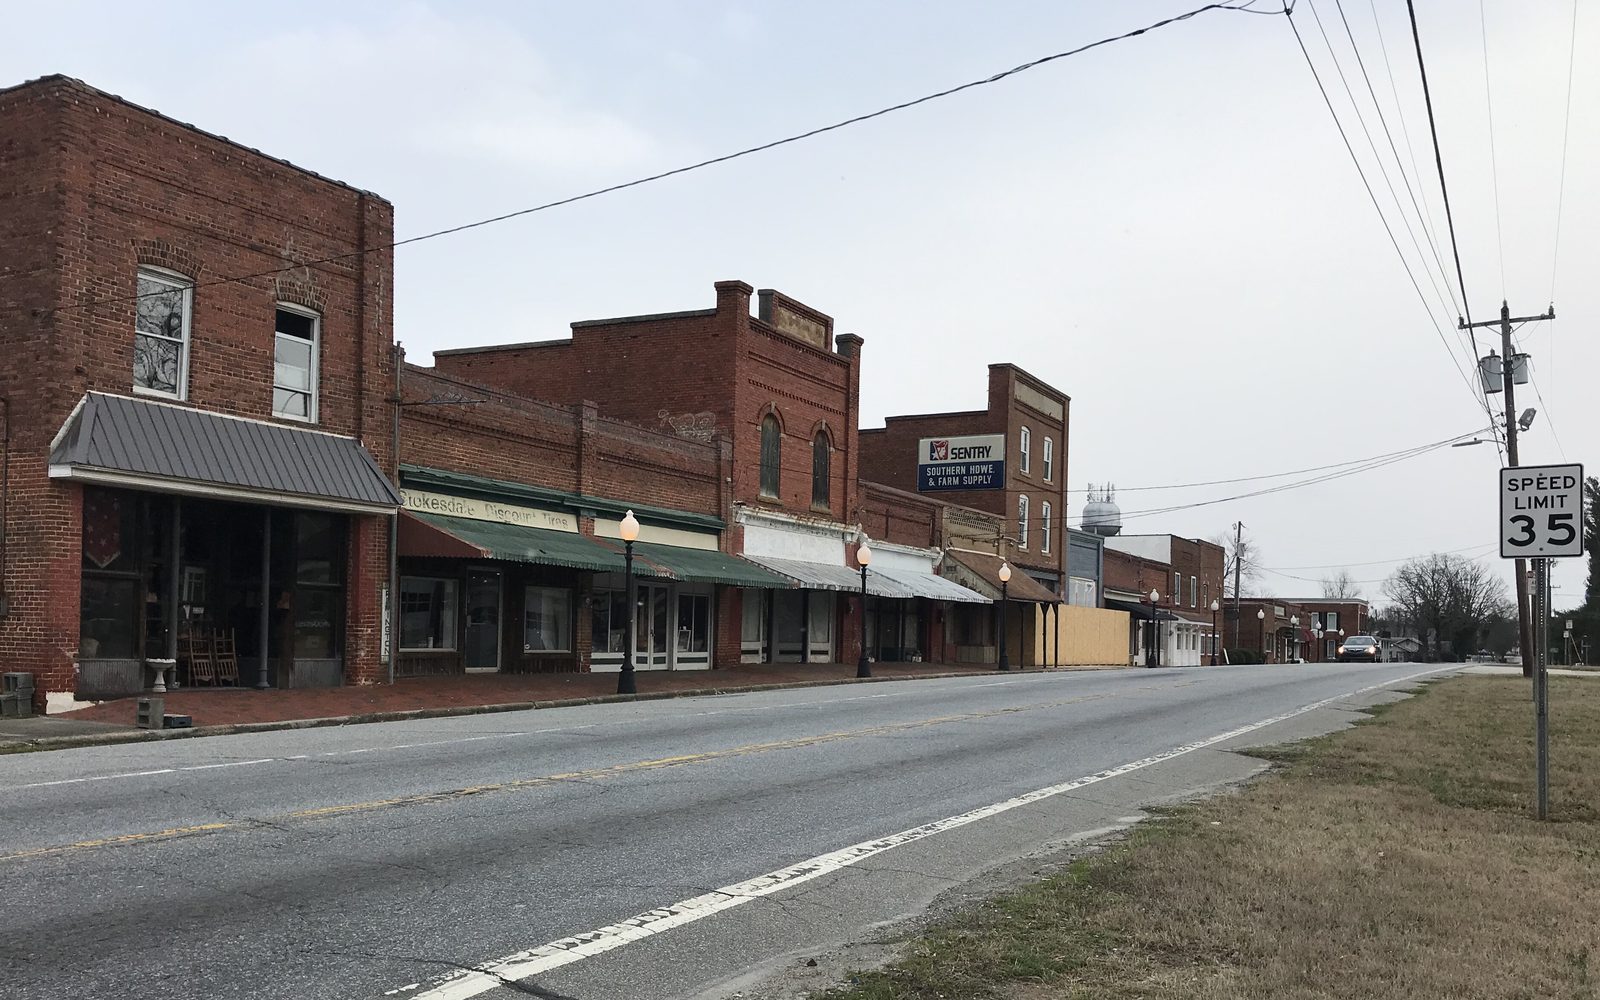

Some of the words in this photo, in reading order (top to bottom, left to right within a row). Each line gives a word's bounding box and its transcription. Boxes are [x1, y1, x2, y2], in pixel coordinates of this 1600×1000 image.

[951, 446, 991, 460] SENTRY
[927, 466, 966, 476] SOUTHERN
[928, 477, 935, 486] &
[938, 476, 959, 486] FARM
[963, 475, 992, 485] SUPPLY
[1507, 476, 1576, 492] SPEED
[1514, 495, 1568, 510] LIMIT
[1507, 513, 1576, 547] 35
